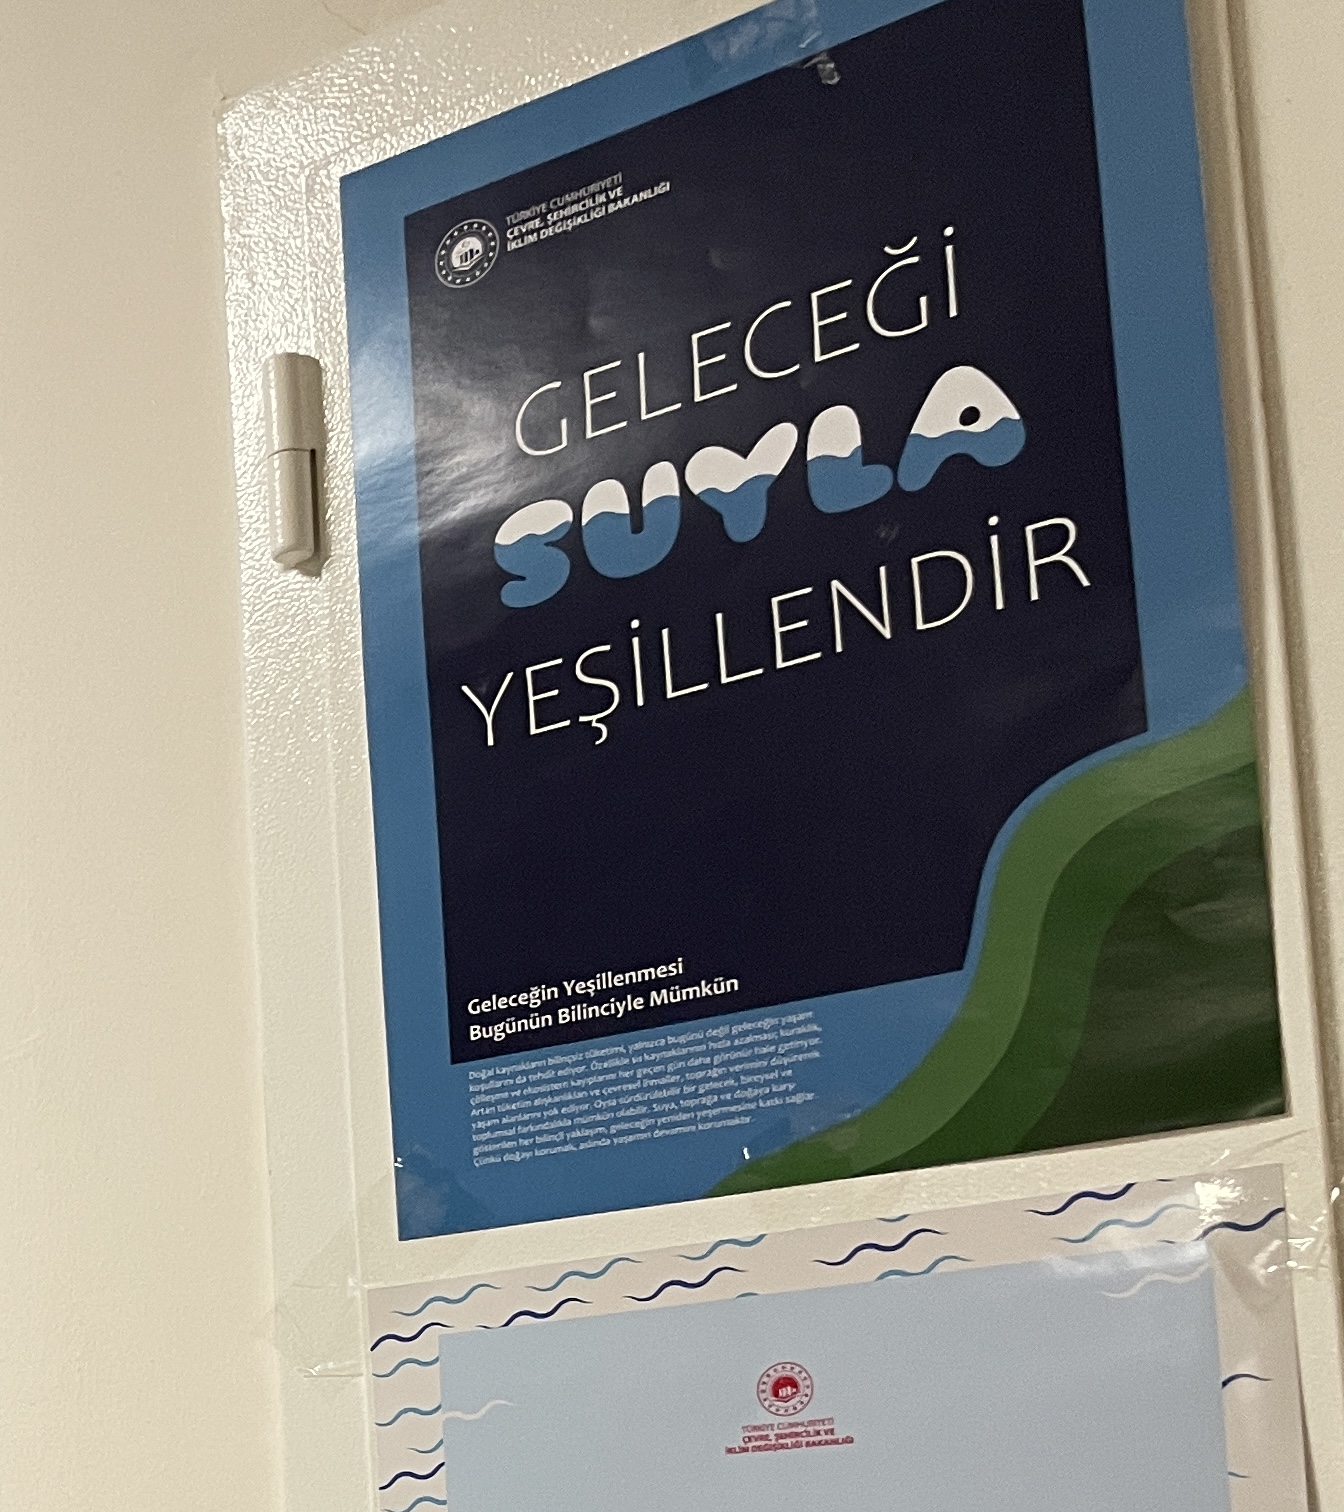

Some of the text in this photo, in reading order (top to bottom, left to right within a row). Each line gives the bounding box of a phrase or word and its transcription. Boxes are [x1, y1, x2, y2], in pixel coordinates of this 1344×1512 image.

[608, 185, 623, 199] VE
[514, 226, 960, 458] GELECEĞİ
[493, 364, 1027, 608] SUYLA
[461, 514, 1092, 746] YEŞİLLENDİR
[467, 957, 684, 1015] Geleceğin Yeşillenmesi
[468, 976, 739, 1042] Bugünün Bilinciyle Mümkün
